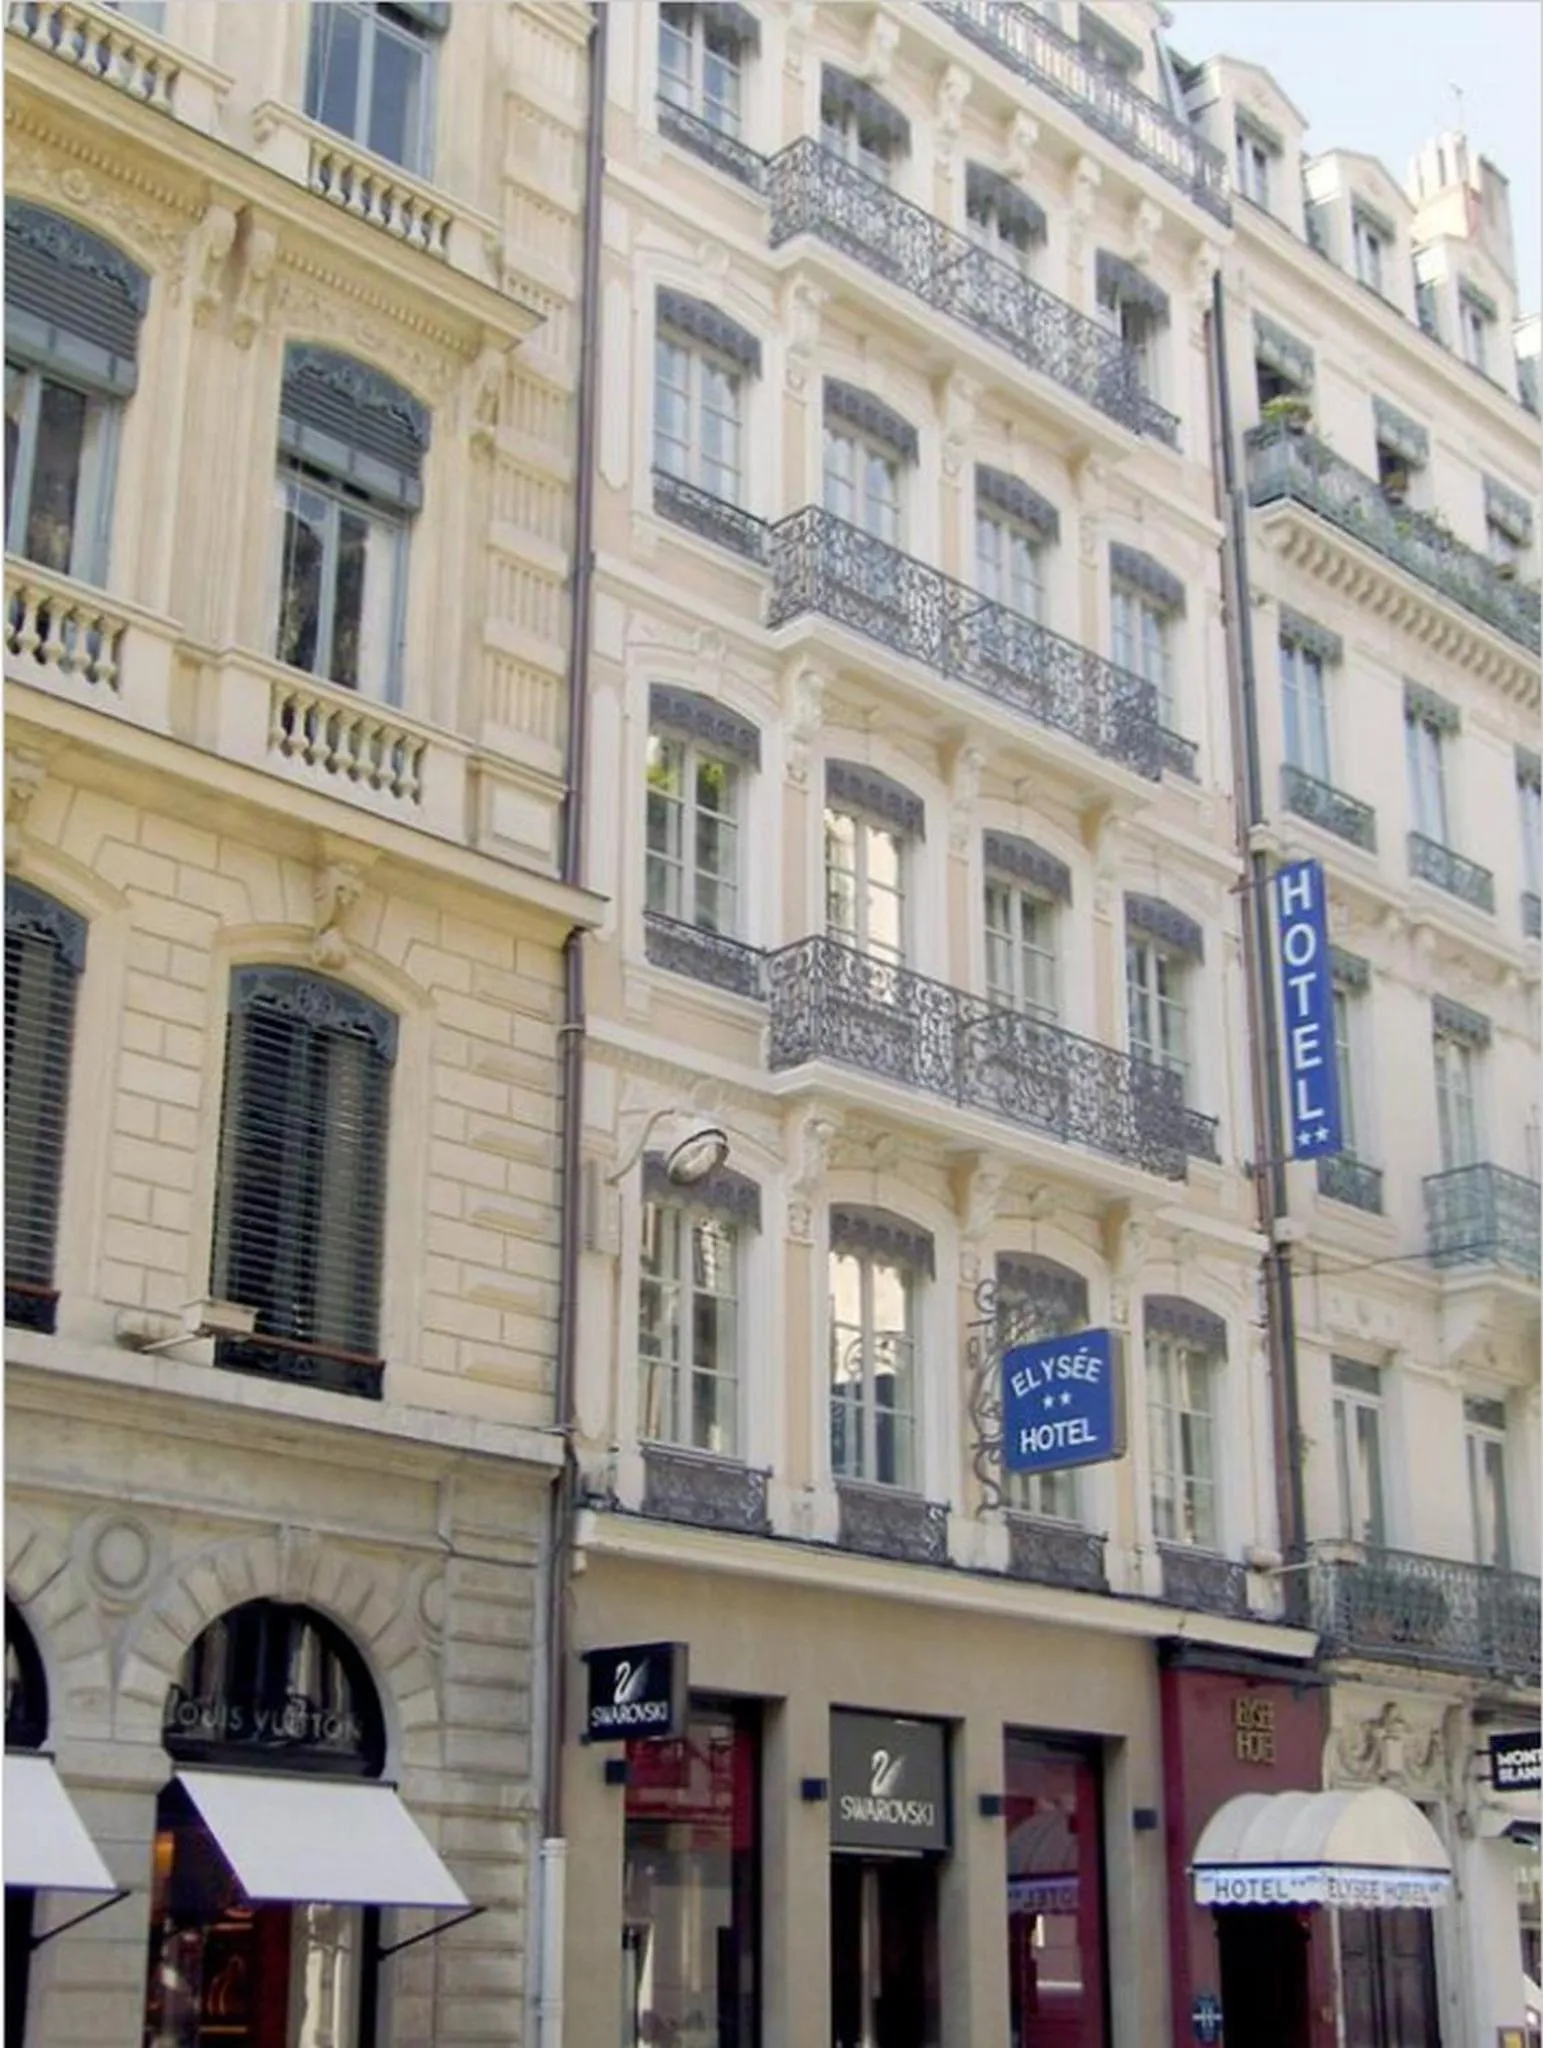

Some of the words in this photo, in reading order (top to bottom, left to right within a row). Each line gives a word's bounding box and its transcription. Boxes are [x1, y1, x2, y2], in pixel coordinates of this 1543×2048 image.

[1280, 867, 1325, 1122] HOTEL
[1009, 1346, 1104, 1399] ELYSÉE
[1019, 1416, 1098, 1454] HOTEL
[591, 1701, 668, 1728] SWAROVSKI
[840, 1794, 935, 1827] SWAROVSKI
[1214, 1878, 1289, 1900] HOTEL
